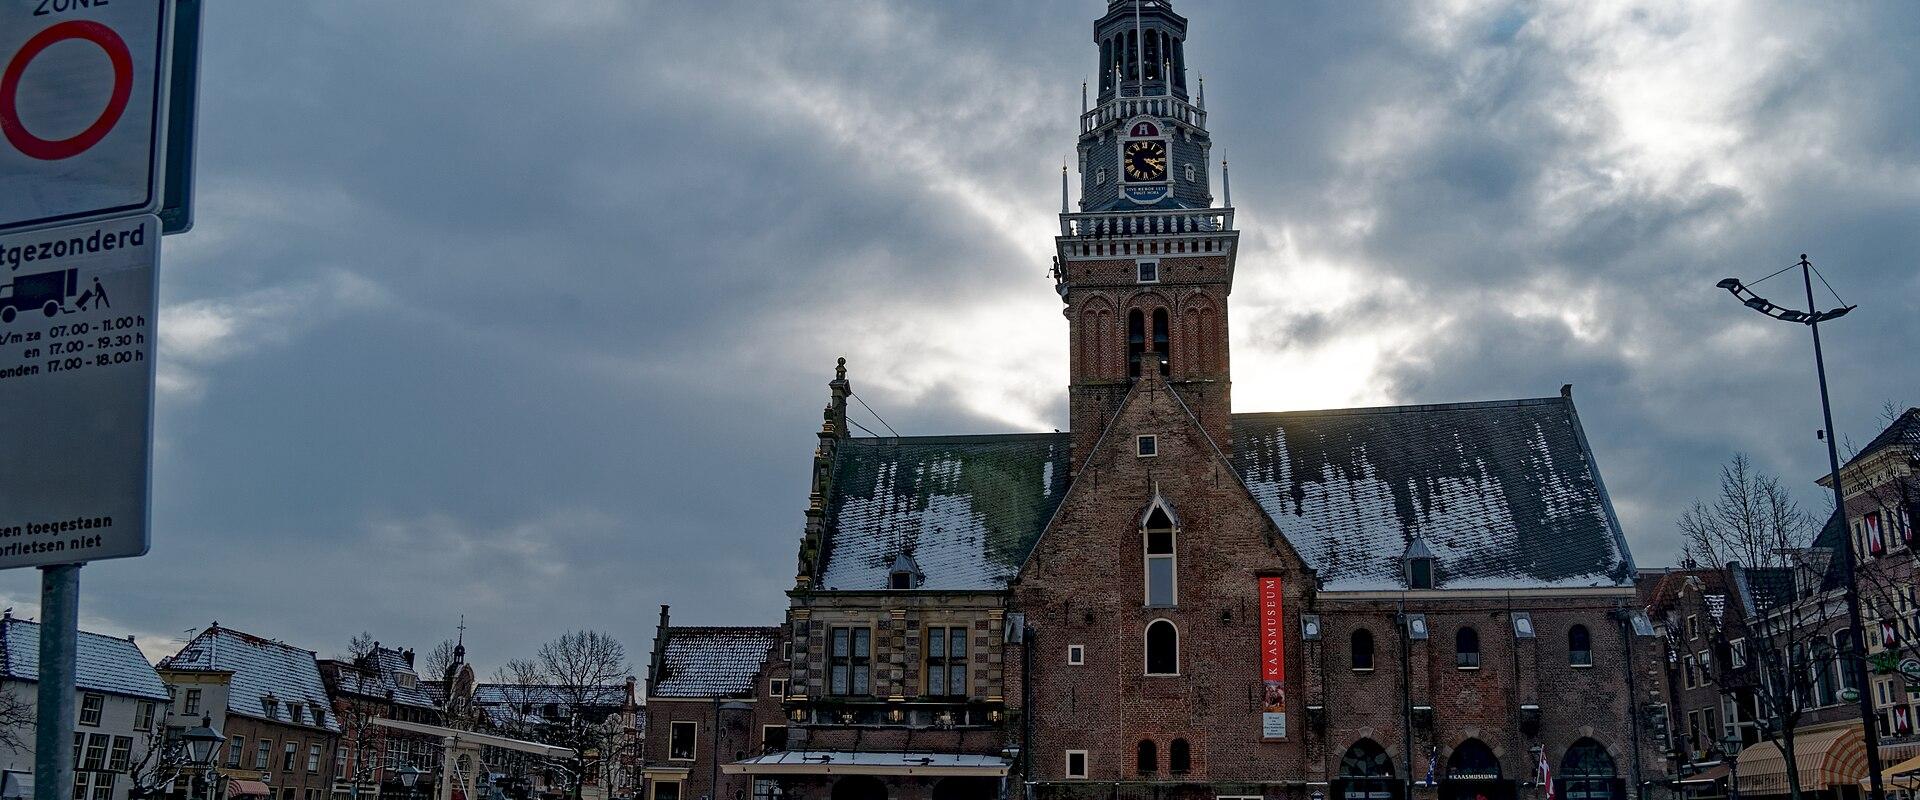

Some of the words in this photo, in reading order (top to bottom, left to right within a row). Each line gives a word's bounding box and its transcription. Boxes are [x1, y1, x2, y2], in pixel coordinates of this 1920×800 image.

[0, 222, 145, 271] tgezonderd
[26, 331, 41, 342] za
[49, 322, 89, 338] 07.00
[102, 316, 133, 331] 11.00
[136, 315, 145, 327] h
[24, 348, 40, 359] en
[49, 340, 84, 355] 17.00
[97, 334, 132, 349] 19.30
[136, 332, 144, 344] h
[0, 364, 40, 379] onden
[48, 357, 82, 373] 17.00
[95, 350, 132, 367] 18.00
[135, 349, 144, 361] h
[26, 516, 112, 536] toegestaan
[70, 534, 102, 549] niet
[1266, 579, 1278, 675] KAASMUSEUM
